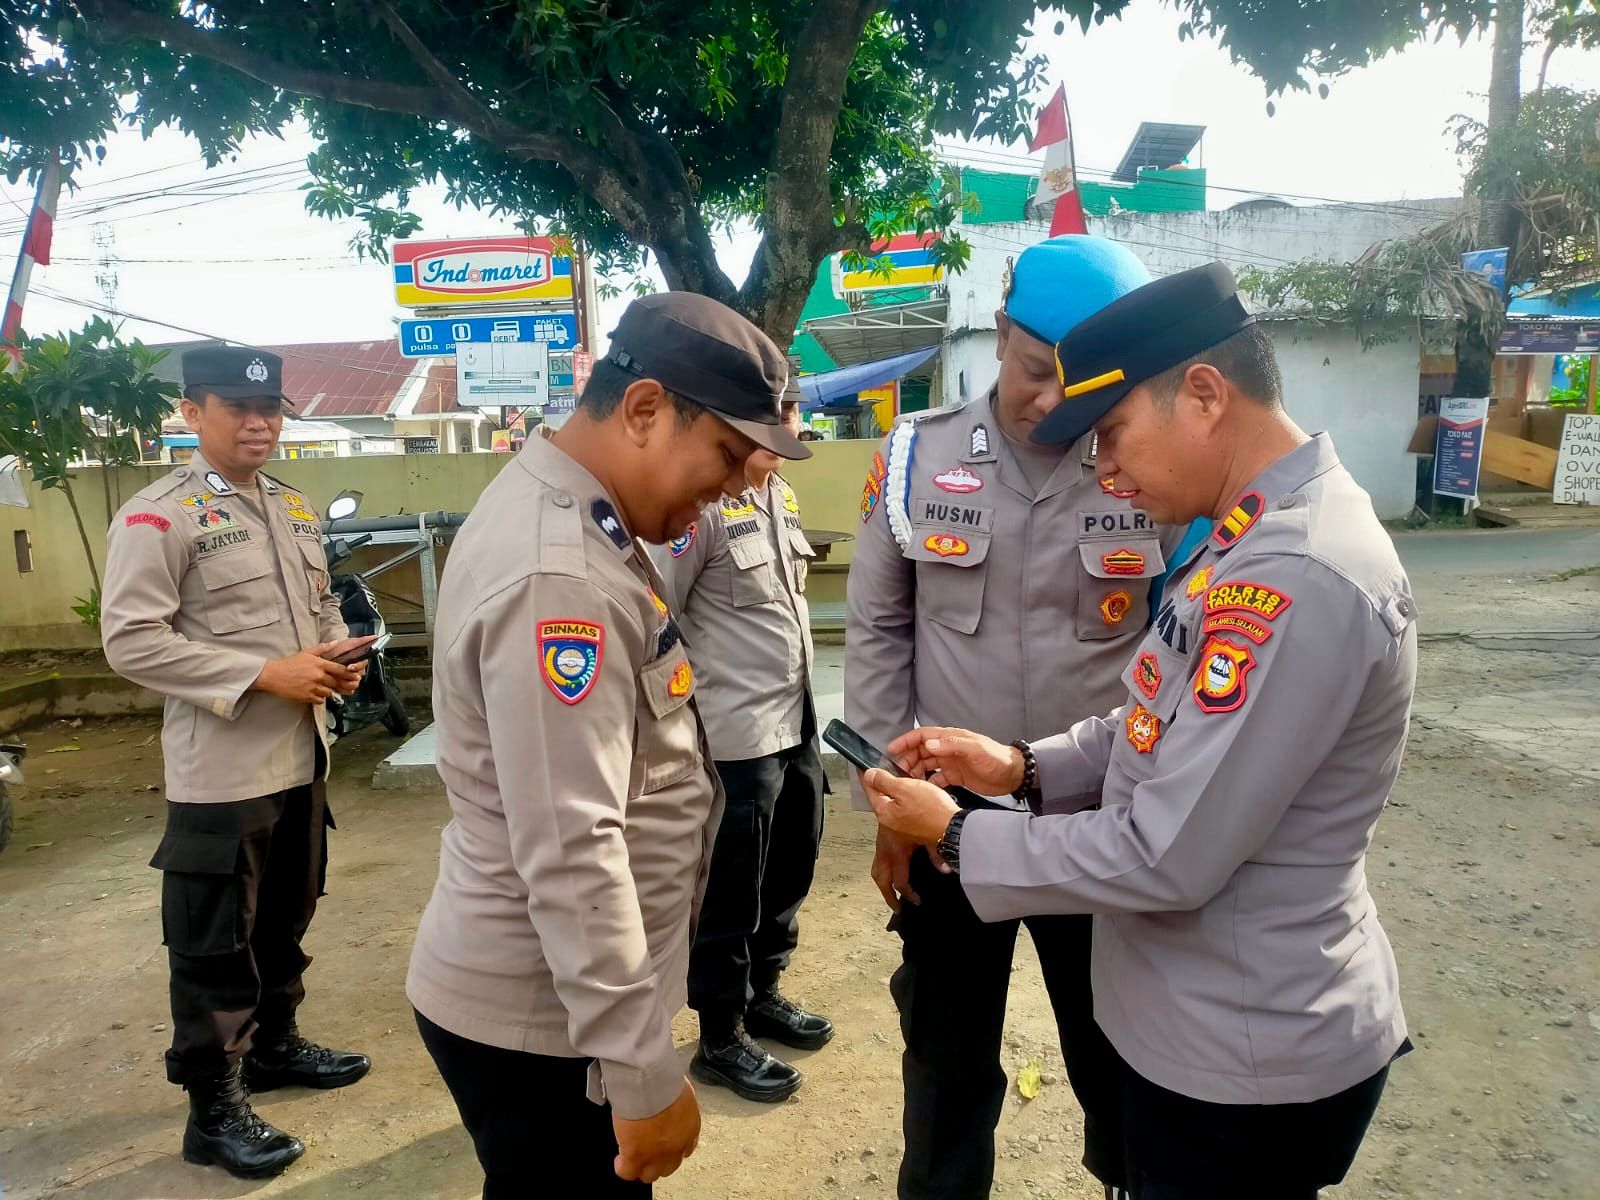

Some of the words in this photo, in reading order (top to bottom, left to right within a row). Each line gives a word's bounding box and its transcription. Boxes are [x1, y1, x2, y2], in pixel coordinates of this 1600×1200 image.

[423, 258, 542, 283] Indomaret
[410, 343, 439, 351] pulsa
[493, 335, 515, 343] DEBIT
[550, 397, 576, 408] atm
[925, 503, 981, 526] HUSNI
[1209, 585, 1281, 608] POLRES
[1207, 595, 1275, 615] TAKALAR
[544, 625, 597, 637] BINMAS
